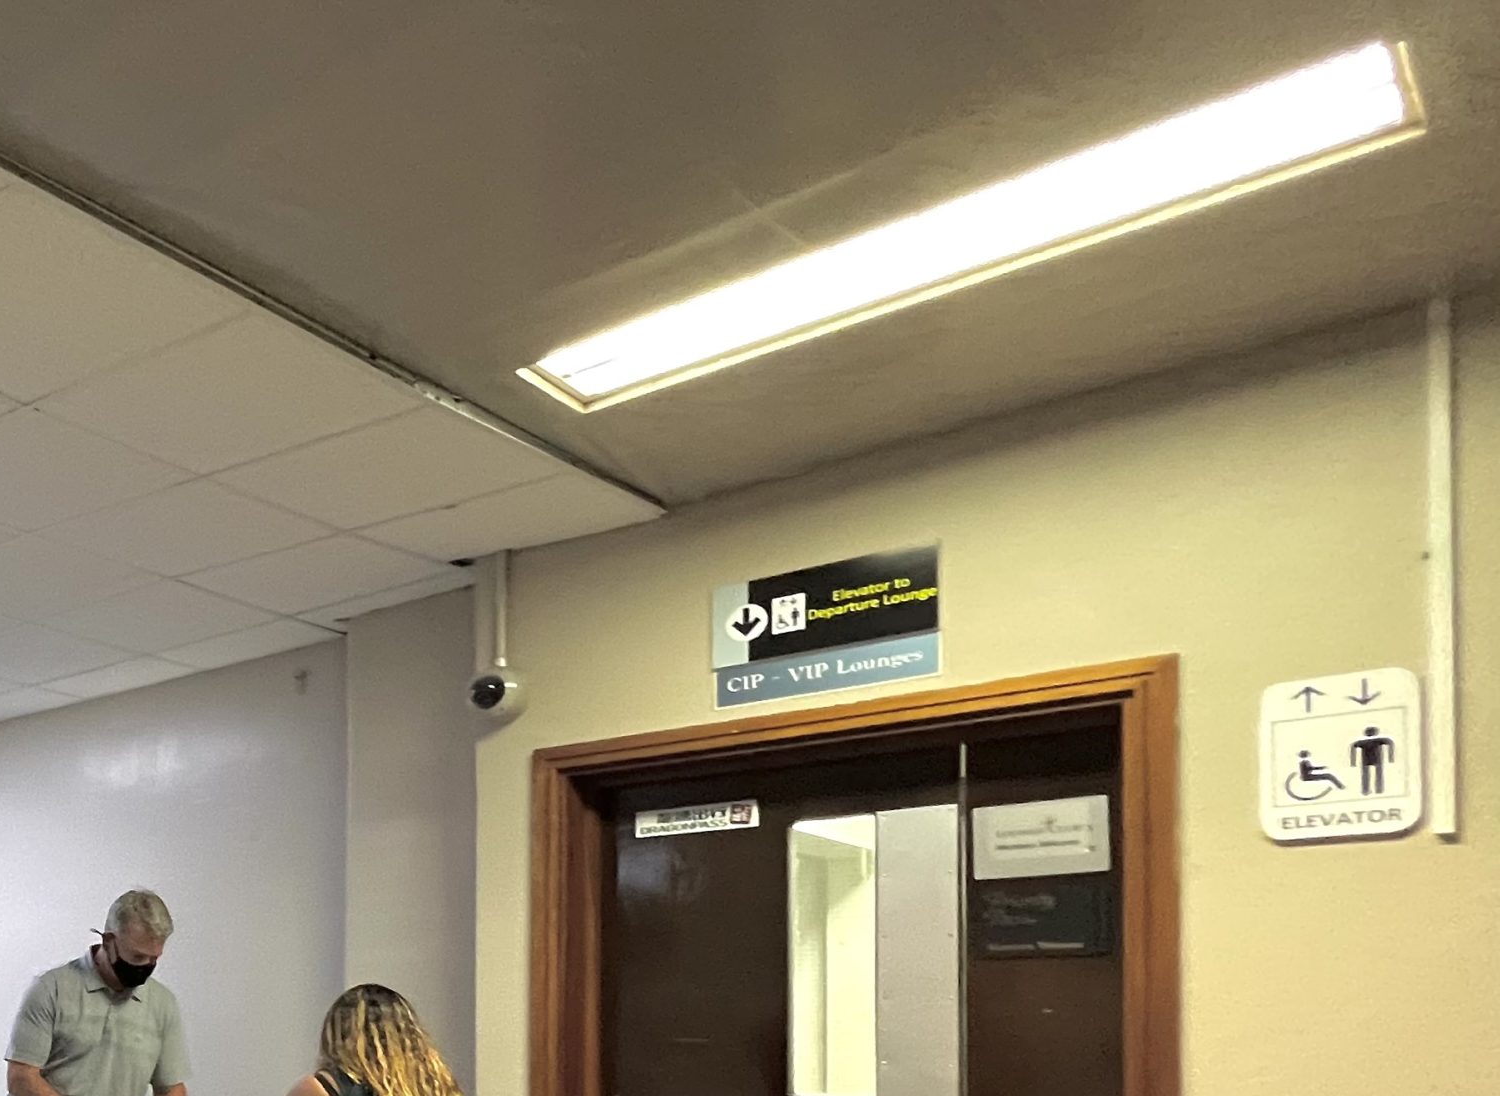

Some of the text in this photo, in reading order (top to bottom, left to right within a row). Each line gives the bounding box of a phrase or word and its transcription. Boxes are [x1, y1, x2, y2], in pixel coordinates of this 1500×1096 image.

[832, 578, 911, 602] Elevator to
[808, 587, 938, 620] Departure Lounge
[726, 673, 765, 693] CIP
[788, 661, 829, 682] VIP
[836, 650, 924, 675] Lounges
[640, 820, 728, 835] DRAGONPASS
[1281, 808, 1402, 829] ELEVATOR
